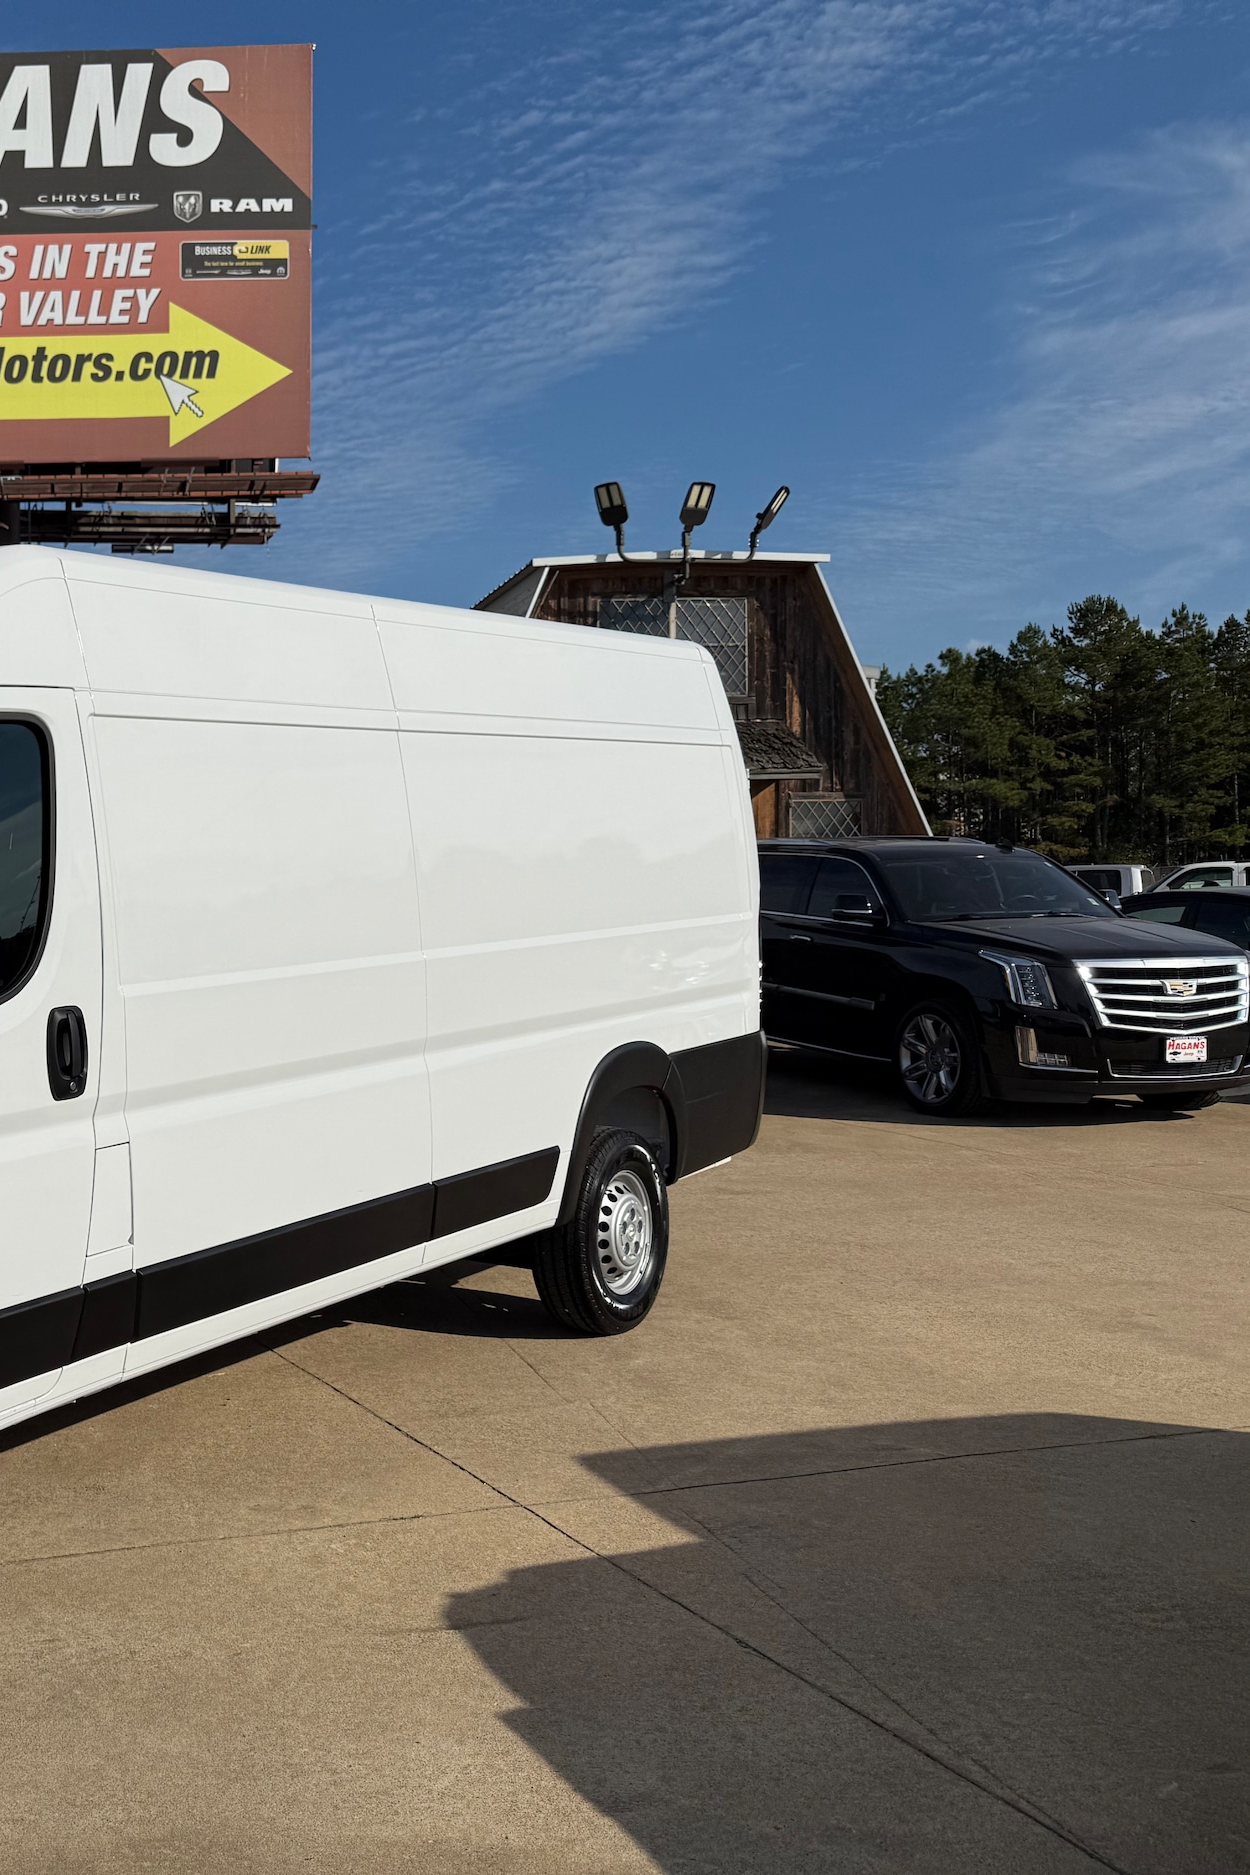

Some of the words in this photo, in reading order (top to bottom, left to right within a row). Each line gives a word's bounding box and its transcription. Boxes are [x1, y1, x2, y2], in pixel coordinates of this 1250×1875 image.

[37, 193, 141, 203] CHRYSLER
[210, 198, 294, 213] RAM
[250, 245, 271, 255] LINK
[29, 244, 72, 280] IN
[84, 242, 156, 278] THE
[20, 288, 161, 327] VALLEY
[1168, 1041, 1205, 1050] HAGANS
